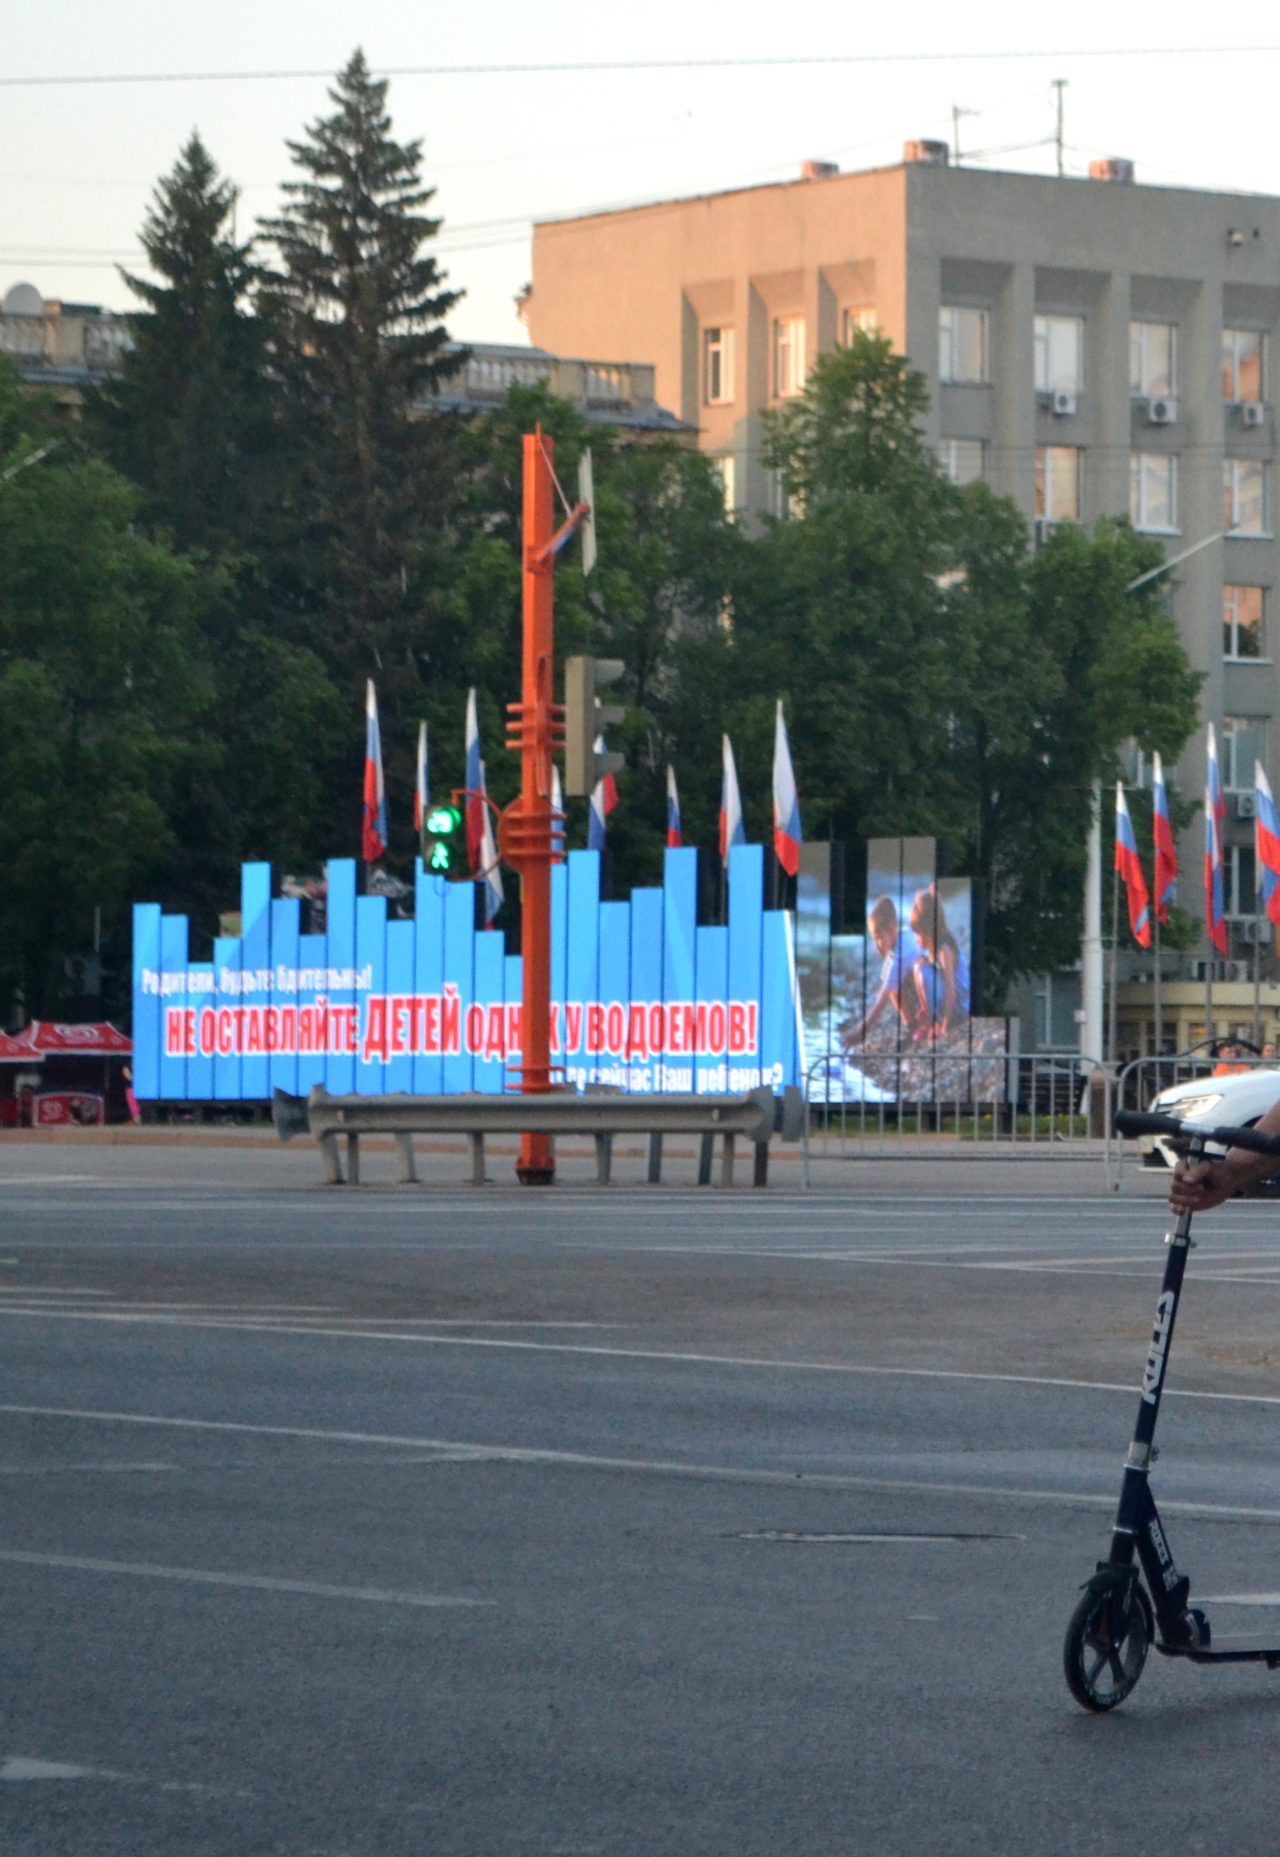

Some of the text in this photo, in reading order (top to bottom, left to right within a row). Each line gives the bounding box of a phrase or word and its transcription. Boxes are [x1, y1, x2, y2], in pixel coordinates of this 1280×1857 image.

[166, 984, 759, 1062] НЕ ОСТАВЛЯЙТЕ ДЕТЕЙ ОДНХ У ВОДОЕМОВ!
[654, 1063, 694, 1093] Ваш
